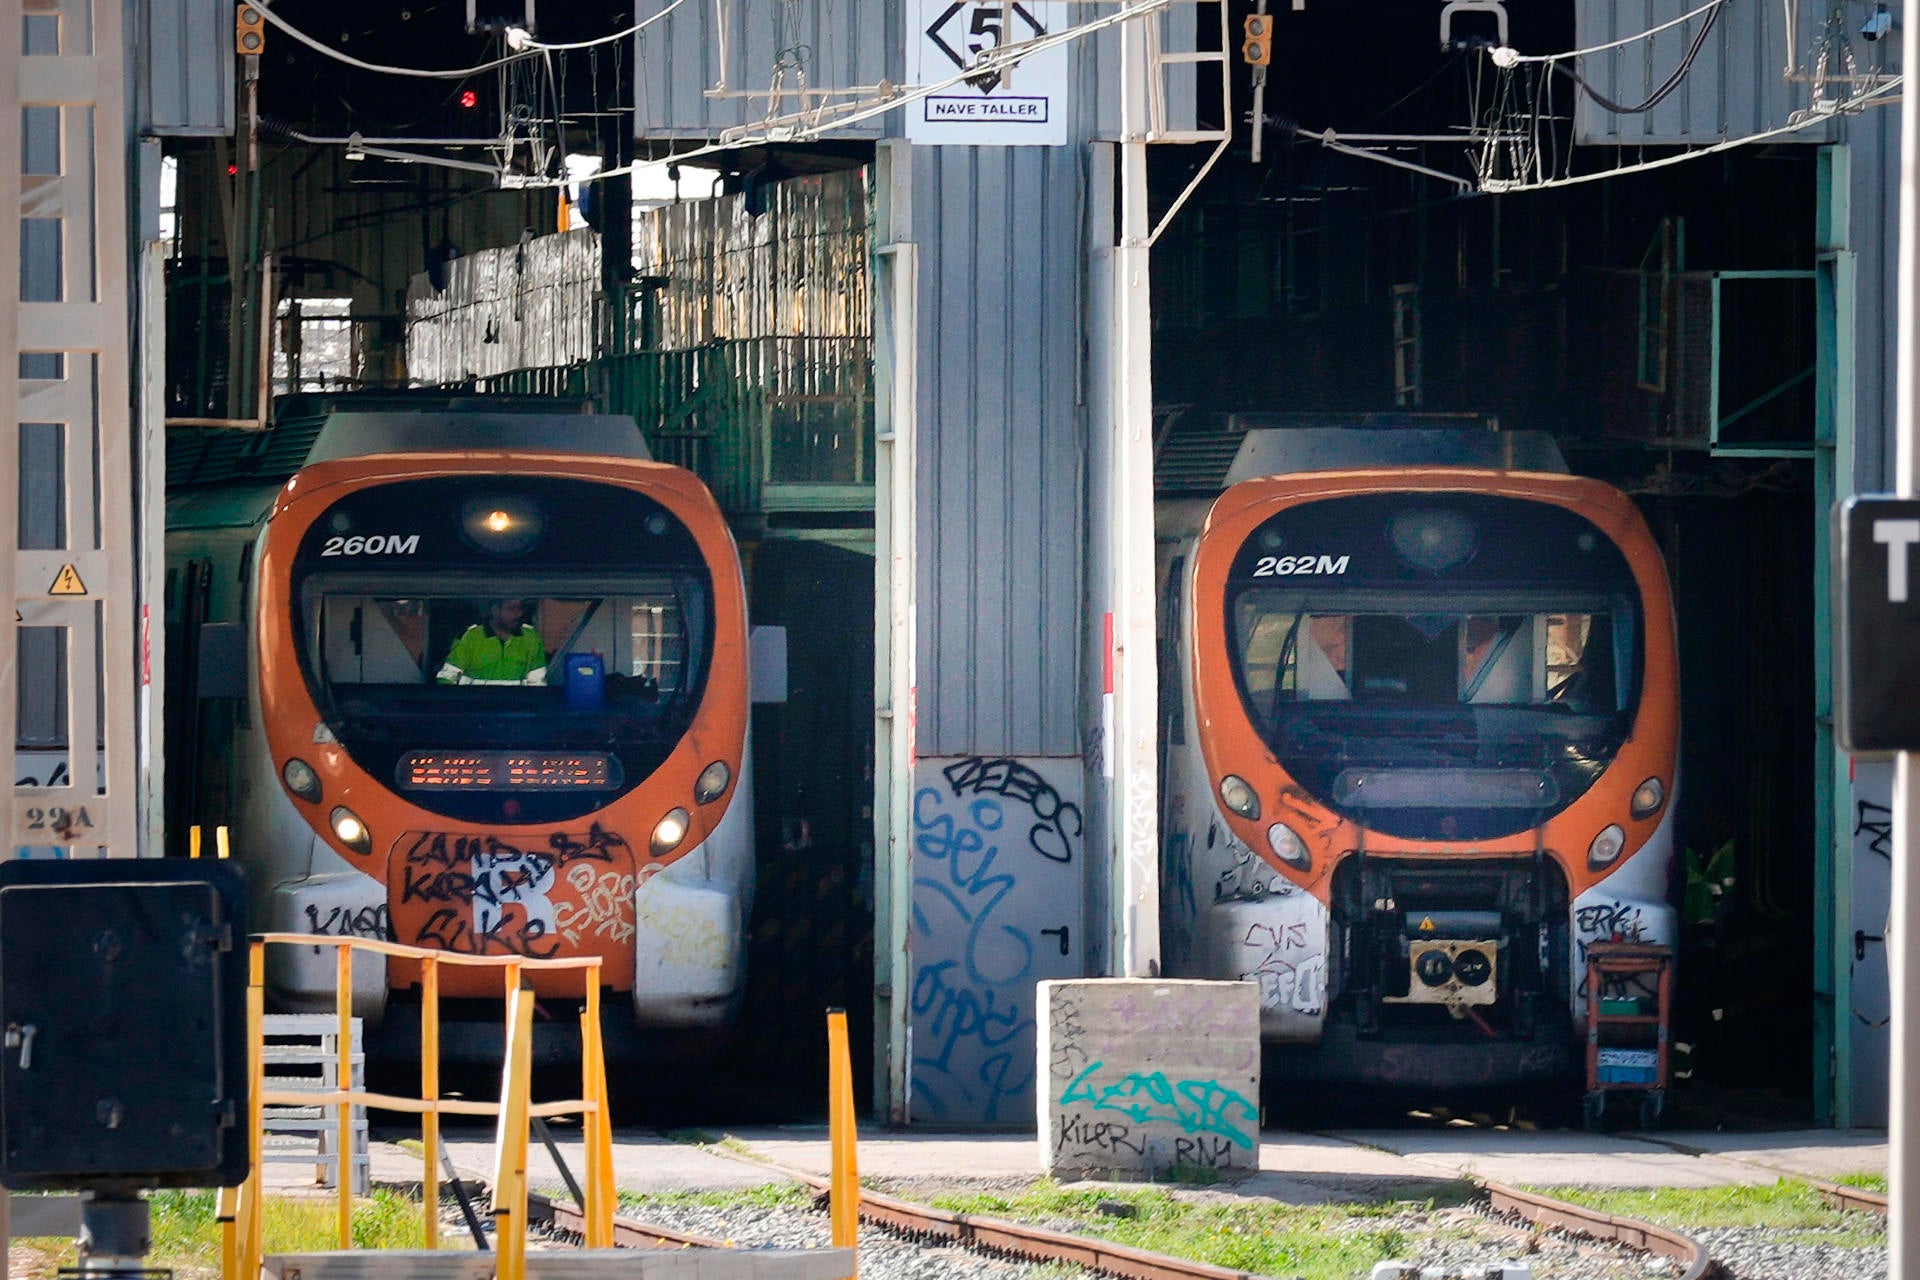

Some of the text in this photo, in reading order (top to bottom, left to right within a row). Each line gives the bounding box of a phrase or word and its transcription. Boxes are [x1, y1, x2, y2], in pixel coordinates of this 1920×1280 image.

[968, 8, 1005, 63] 5
[935, 104, 1038, 115] NAVE TALLER
[321, 534, 420, 557] 260M
[1252, 555, 1351, 577] 262M
[1872, 519, 1920, 603] T
[25, 805, 95, 830] 22A
